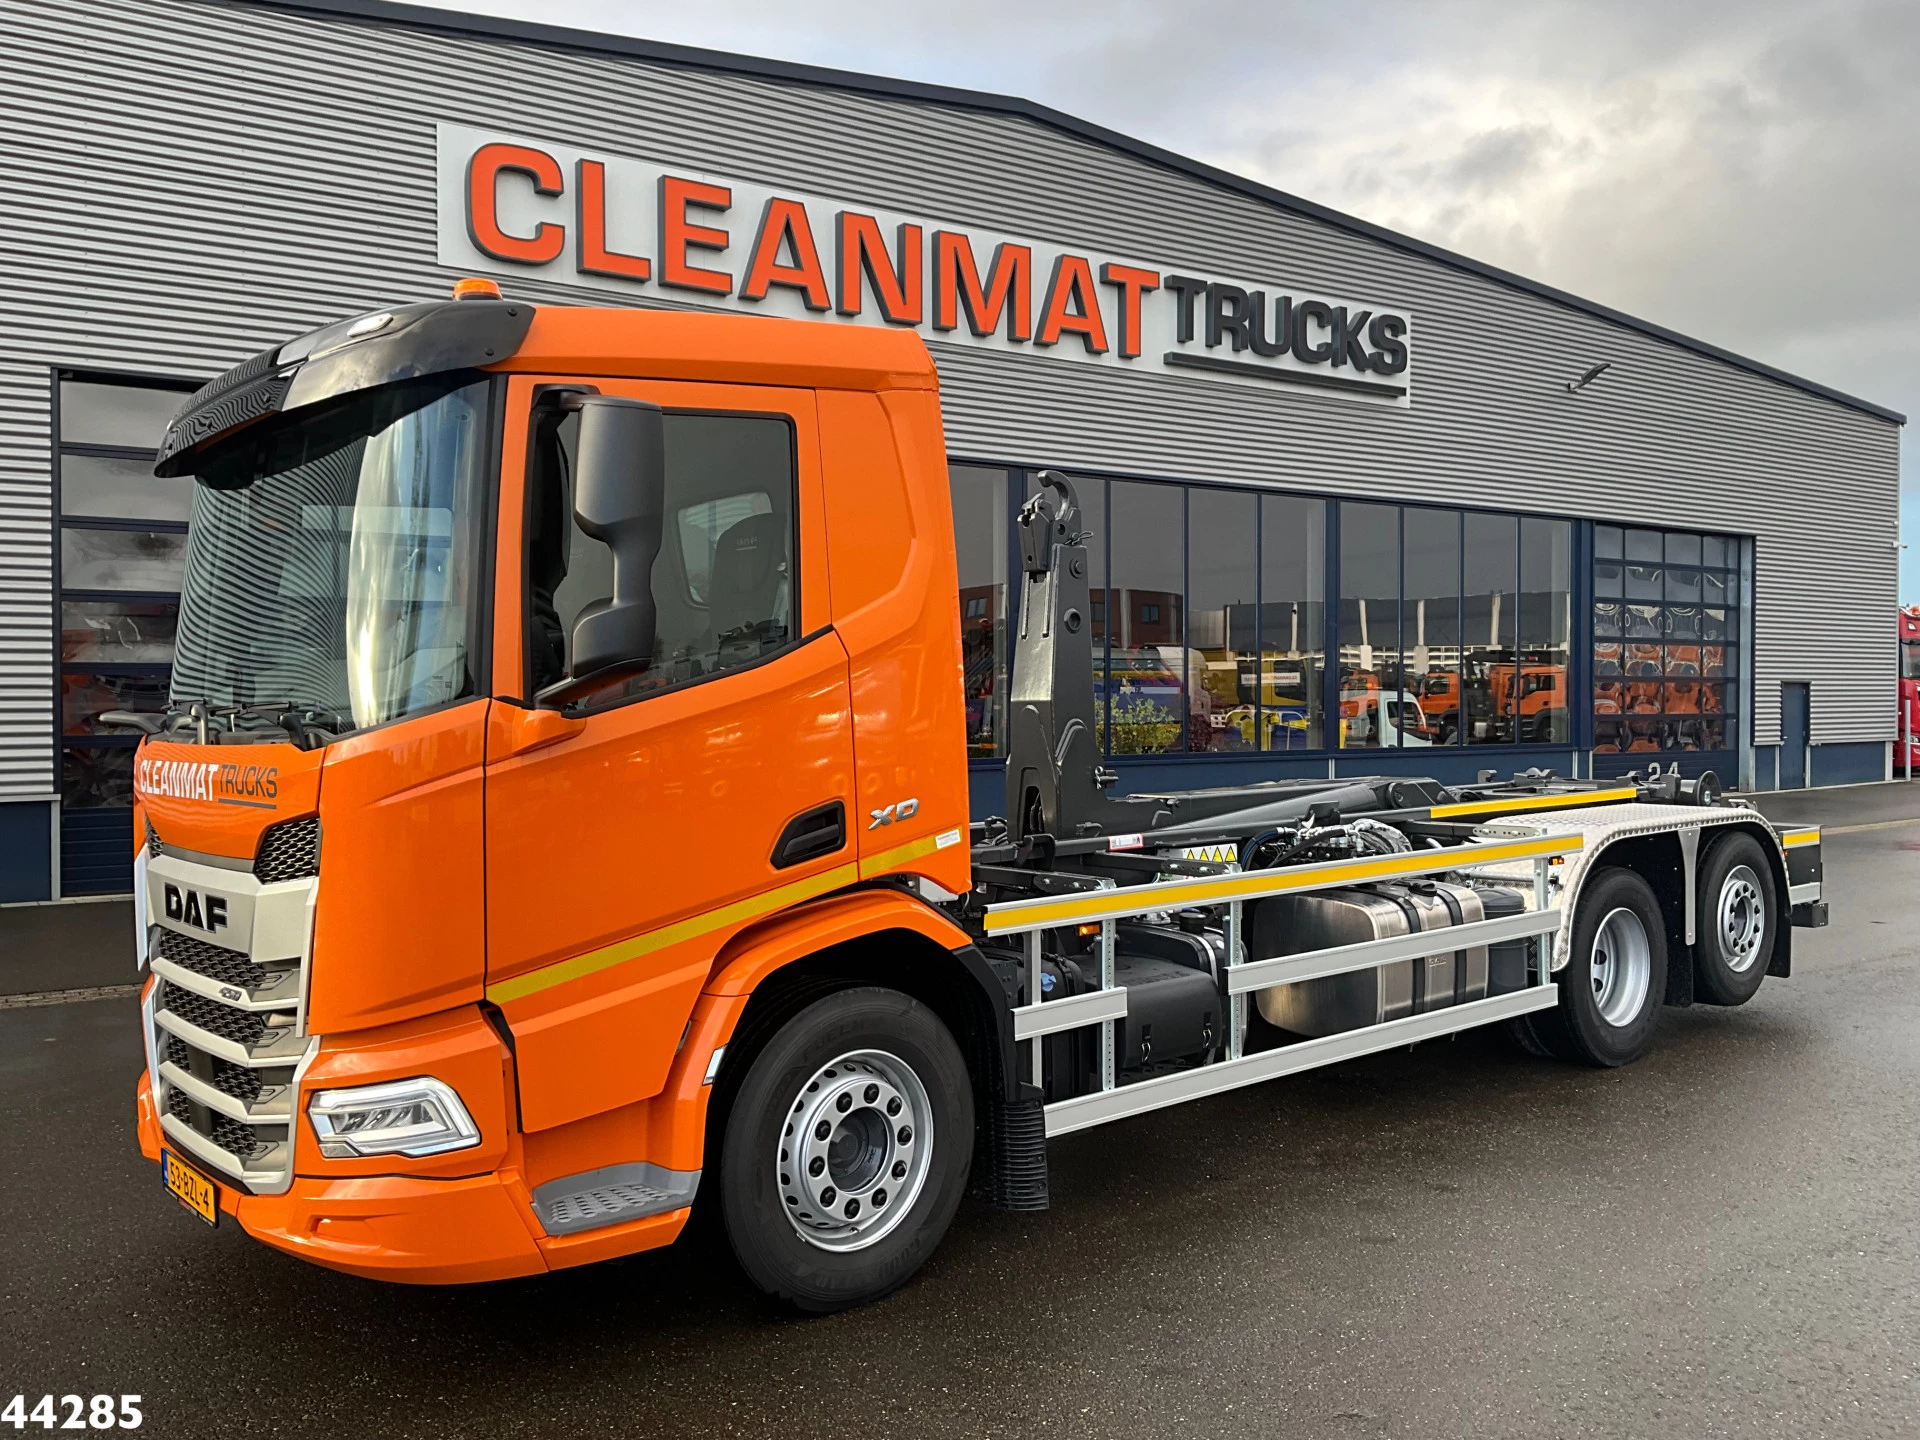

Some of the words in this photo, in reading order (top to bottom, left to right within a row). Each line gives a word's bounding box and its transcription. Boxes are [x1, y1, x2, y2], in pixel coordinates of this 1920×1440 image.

[465, 142, 1160, 359] CLEANMAT
[1164, 274, 1407, 376] TRUCKS
[140, 759, 219, 802] CLEANMAT
[220, 763, 278, 799] TRUCKS
[868, 798, 919, 831] XD
[164, 881, 228, 934] DAF
[170, 1161, 209, 1213] 53-BZL-4
